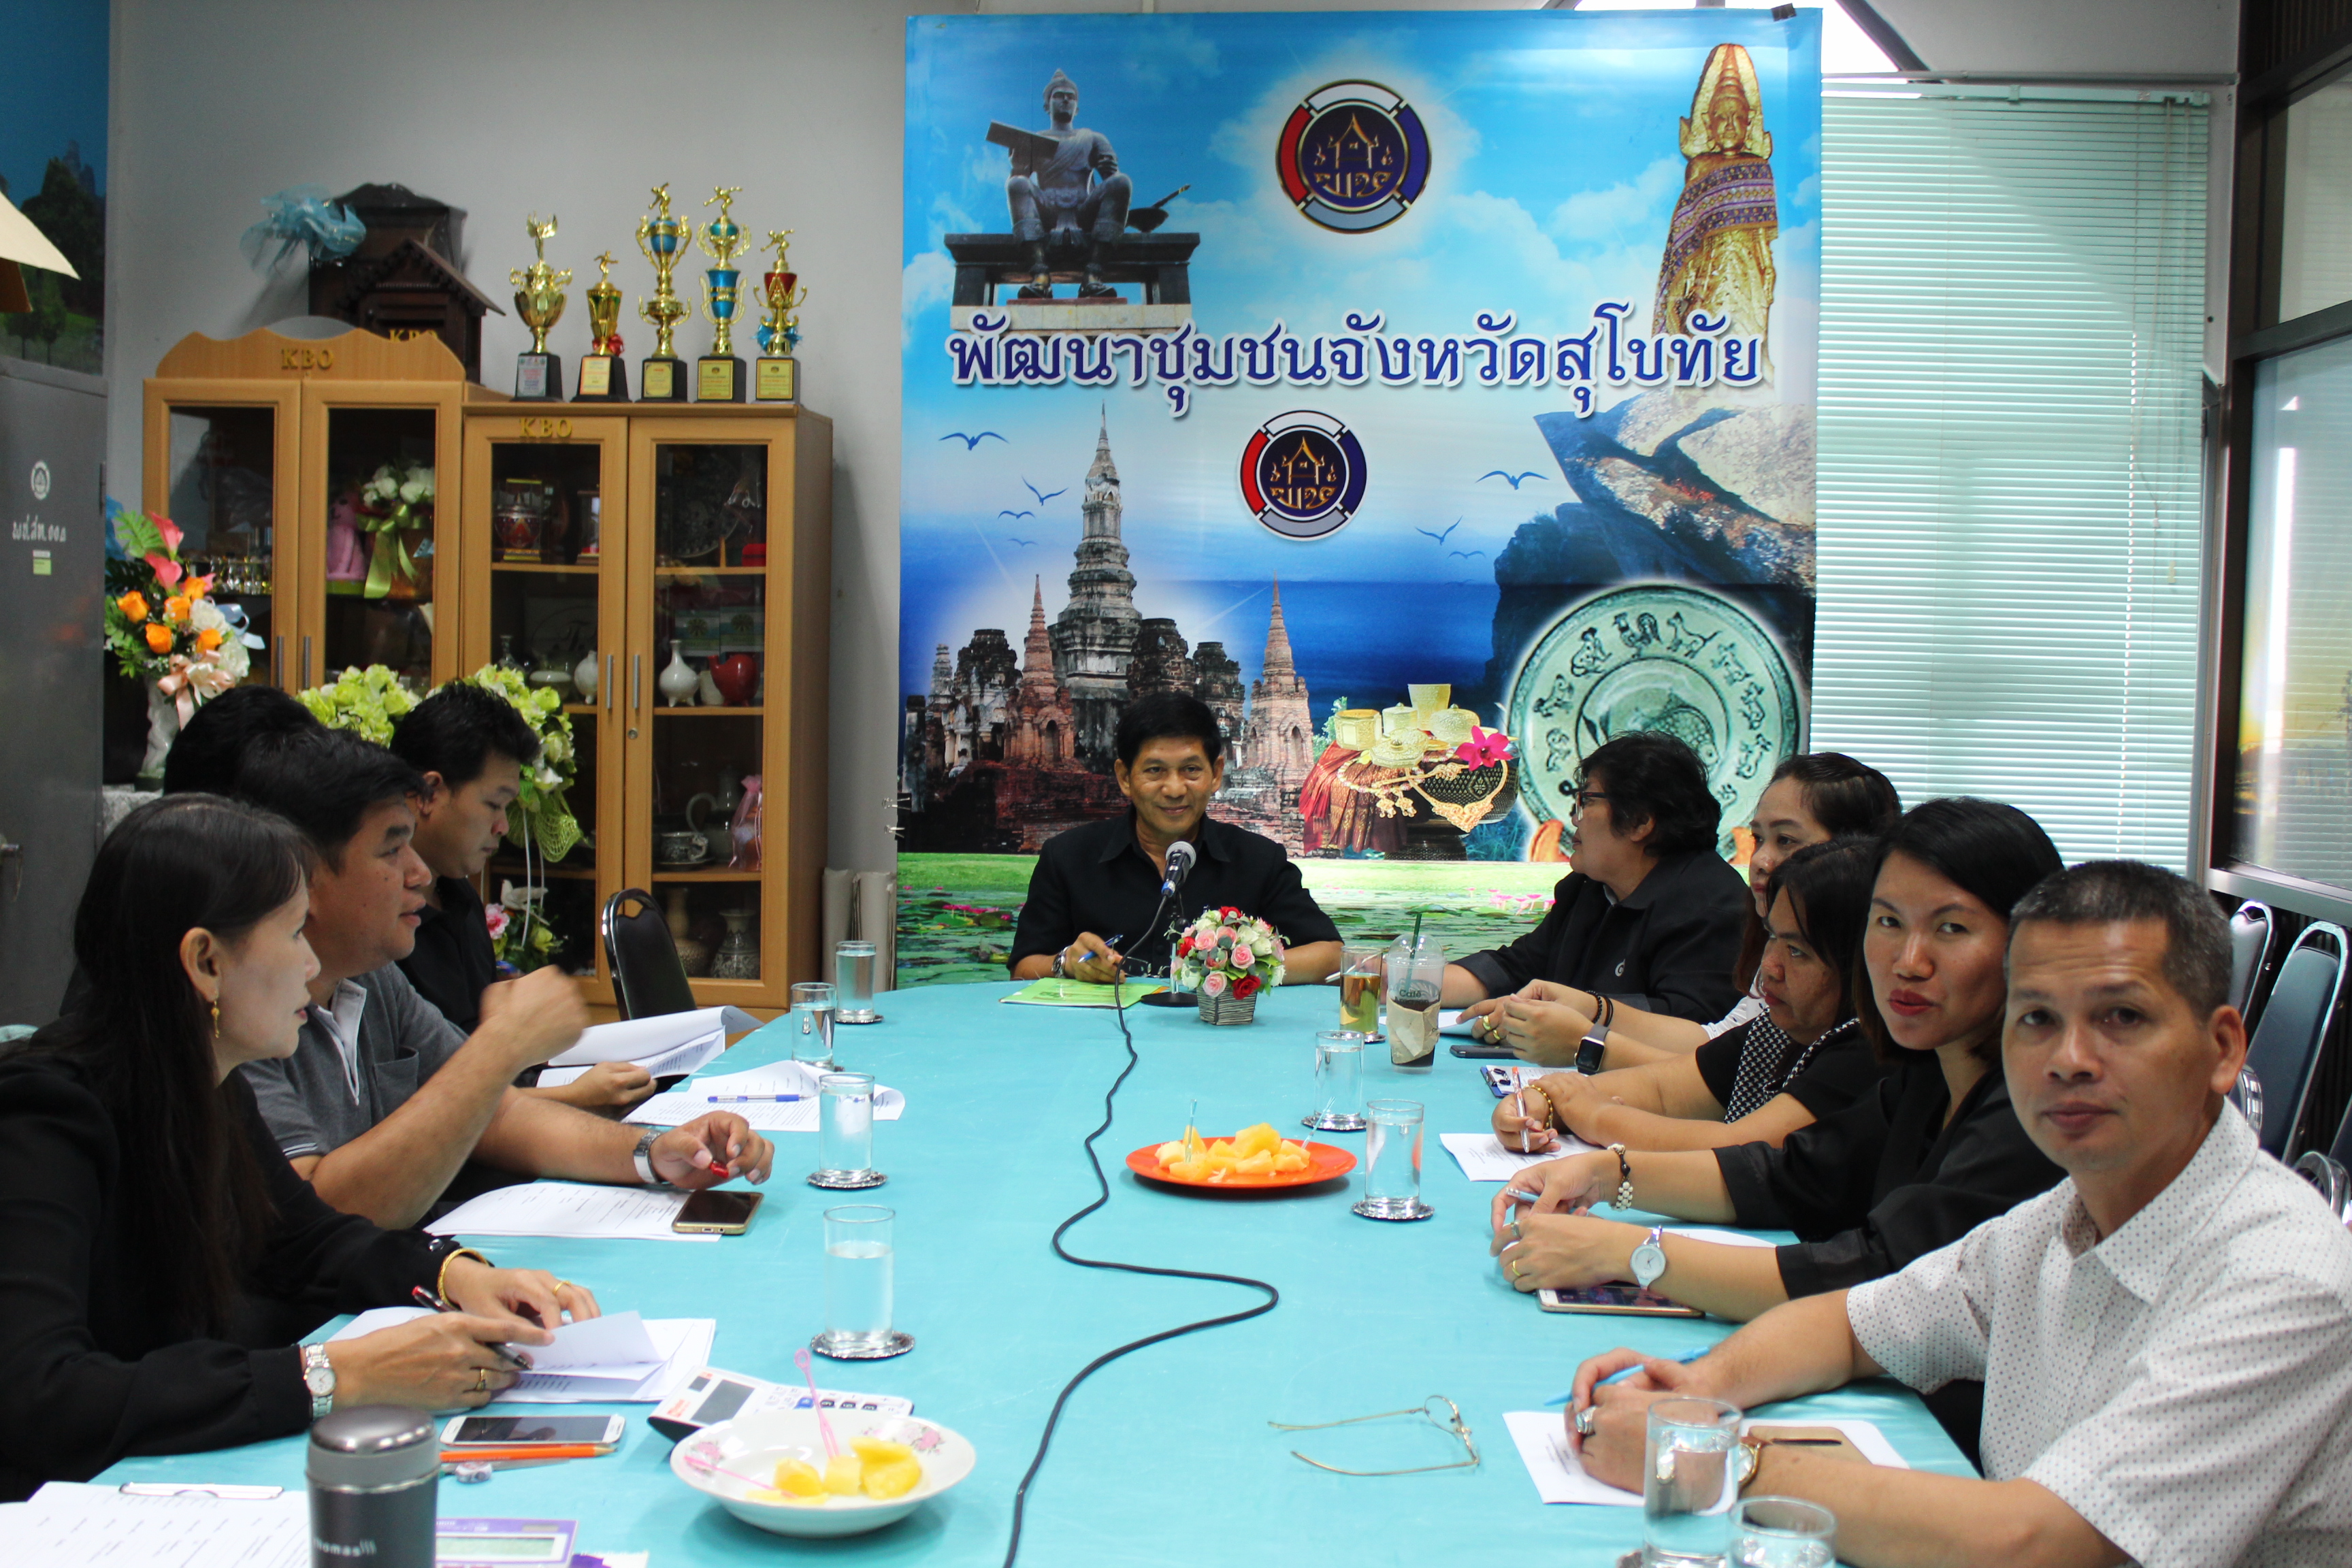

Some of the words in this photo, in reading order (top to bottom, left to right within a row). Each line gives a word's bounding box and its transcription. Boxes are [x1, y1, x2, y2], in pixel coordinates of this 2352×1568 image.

[281, 348, 334, 370] KBO
[949, 301, 1763, 414] พัฒนาชุมชนจังหวัดสุโขทัย
[519, 417, 572, 438] KBO
